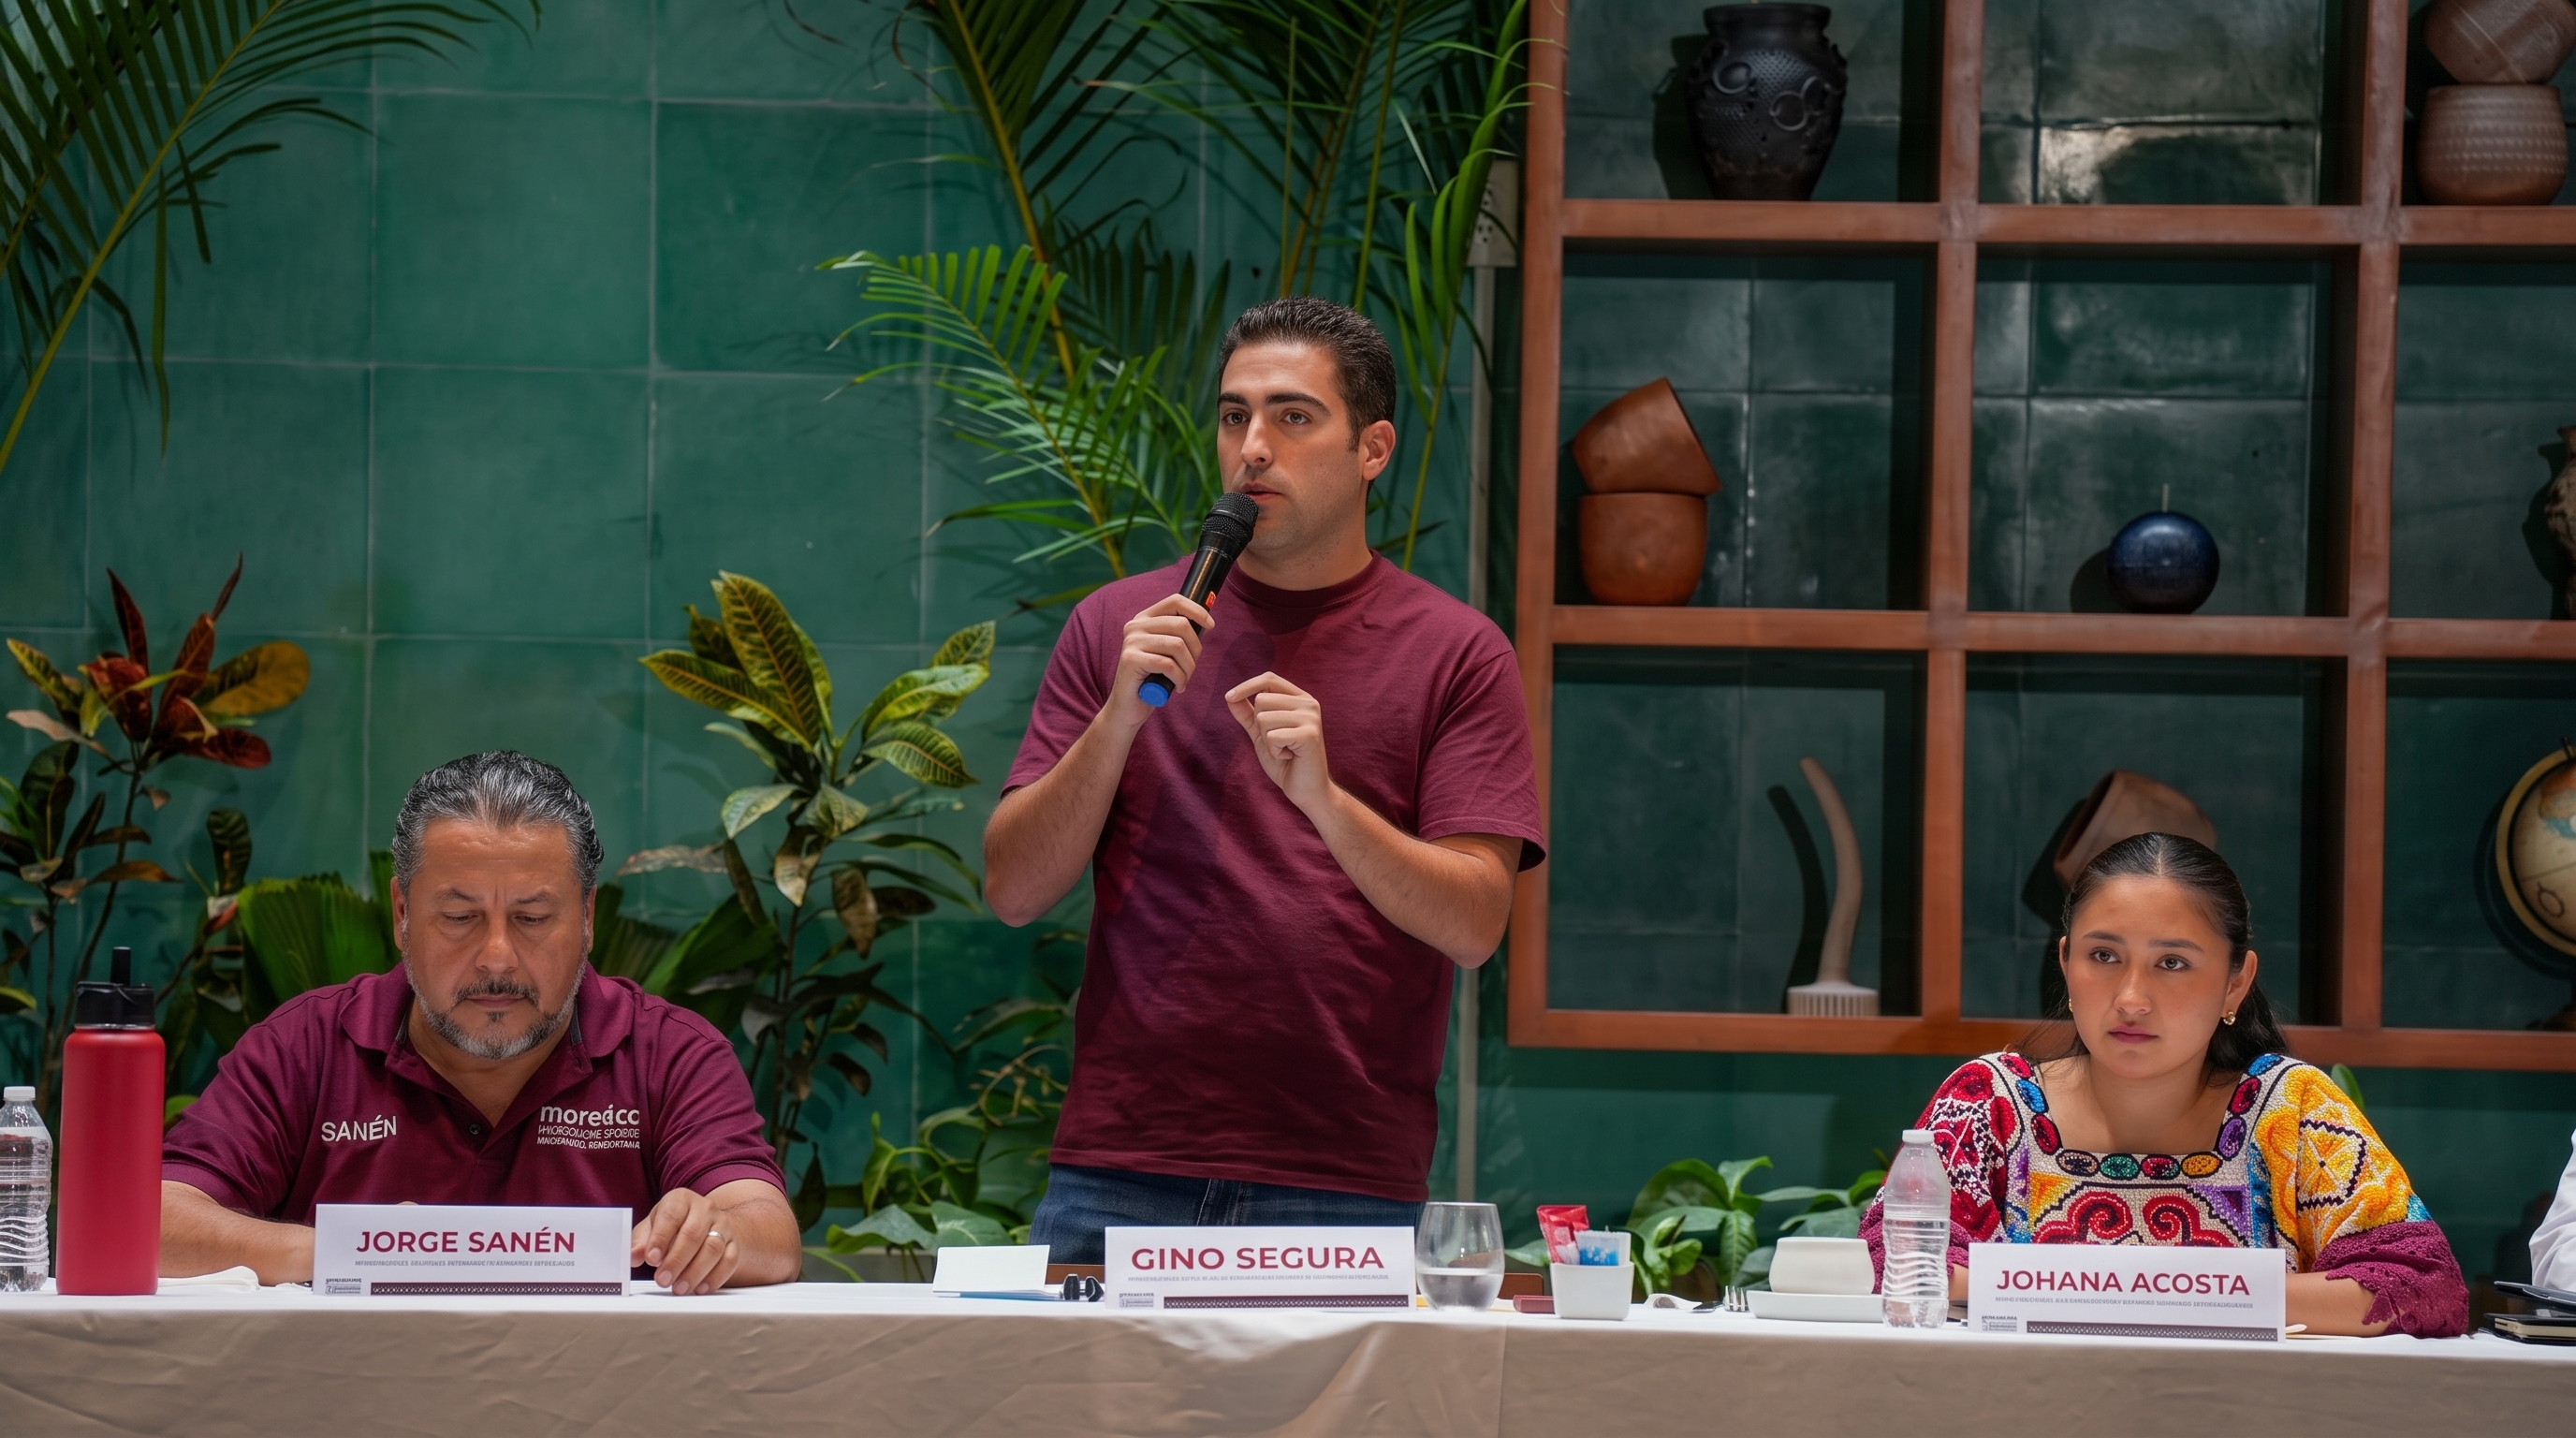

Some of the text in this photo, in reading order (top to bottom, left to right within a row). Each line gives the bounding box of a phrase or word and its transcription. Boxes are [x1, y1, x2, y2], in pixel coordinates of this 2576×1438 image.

[321, 1114, 397, 1142] SANÉN
[357, 1226, 575, 1253] JORGE SANÉN
[1131, 1246, 1384, 1270] GINO SEGURA
[1997, 1269, 2250, 1296] JOHANA ACOSTA
